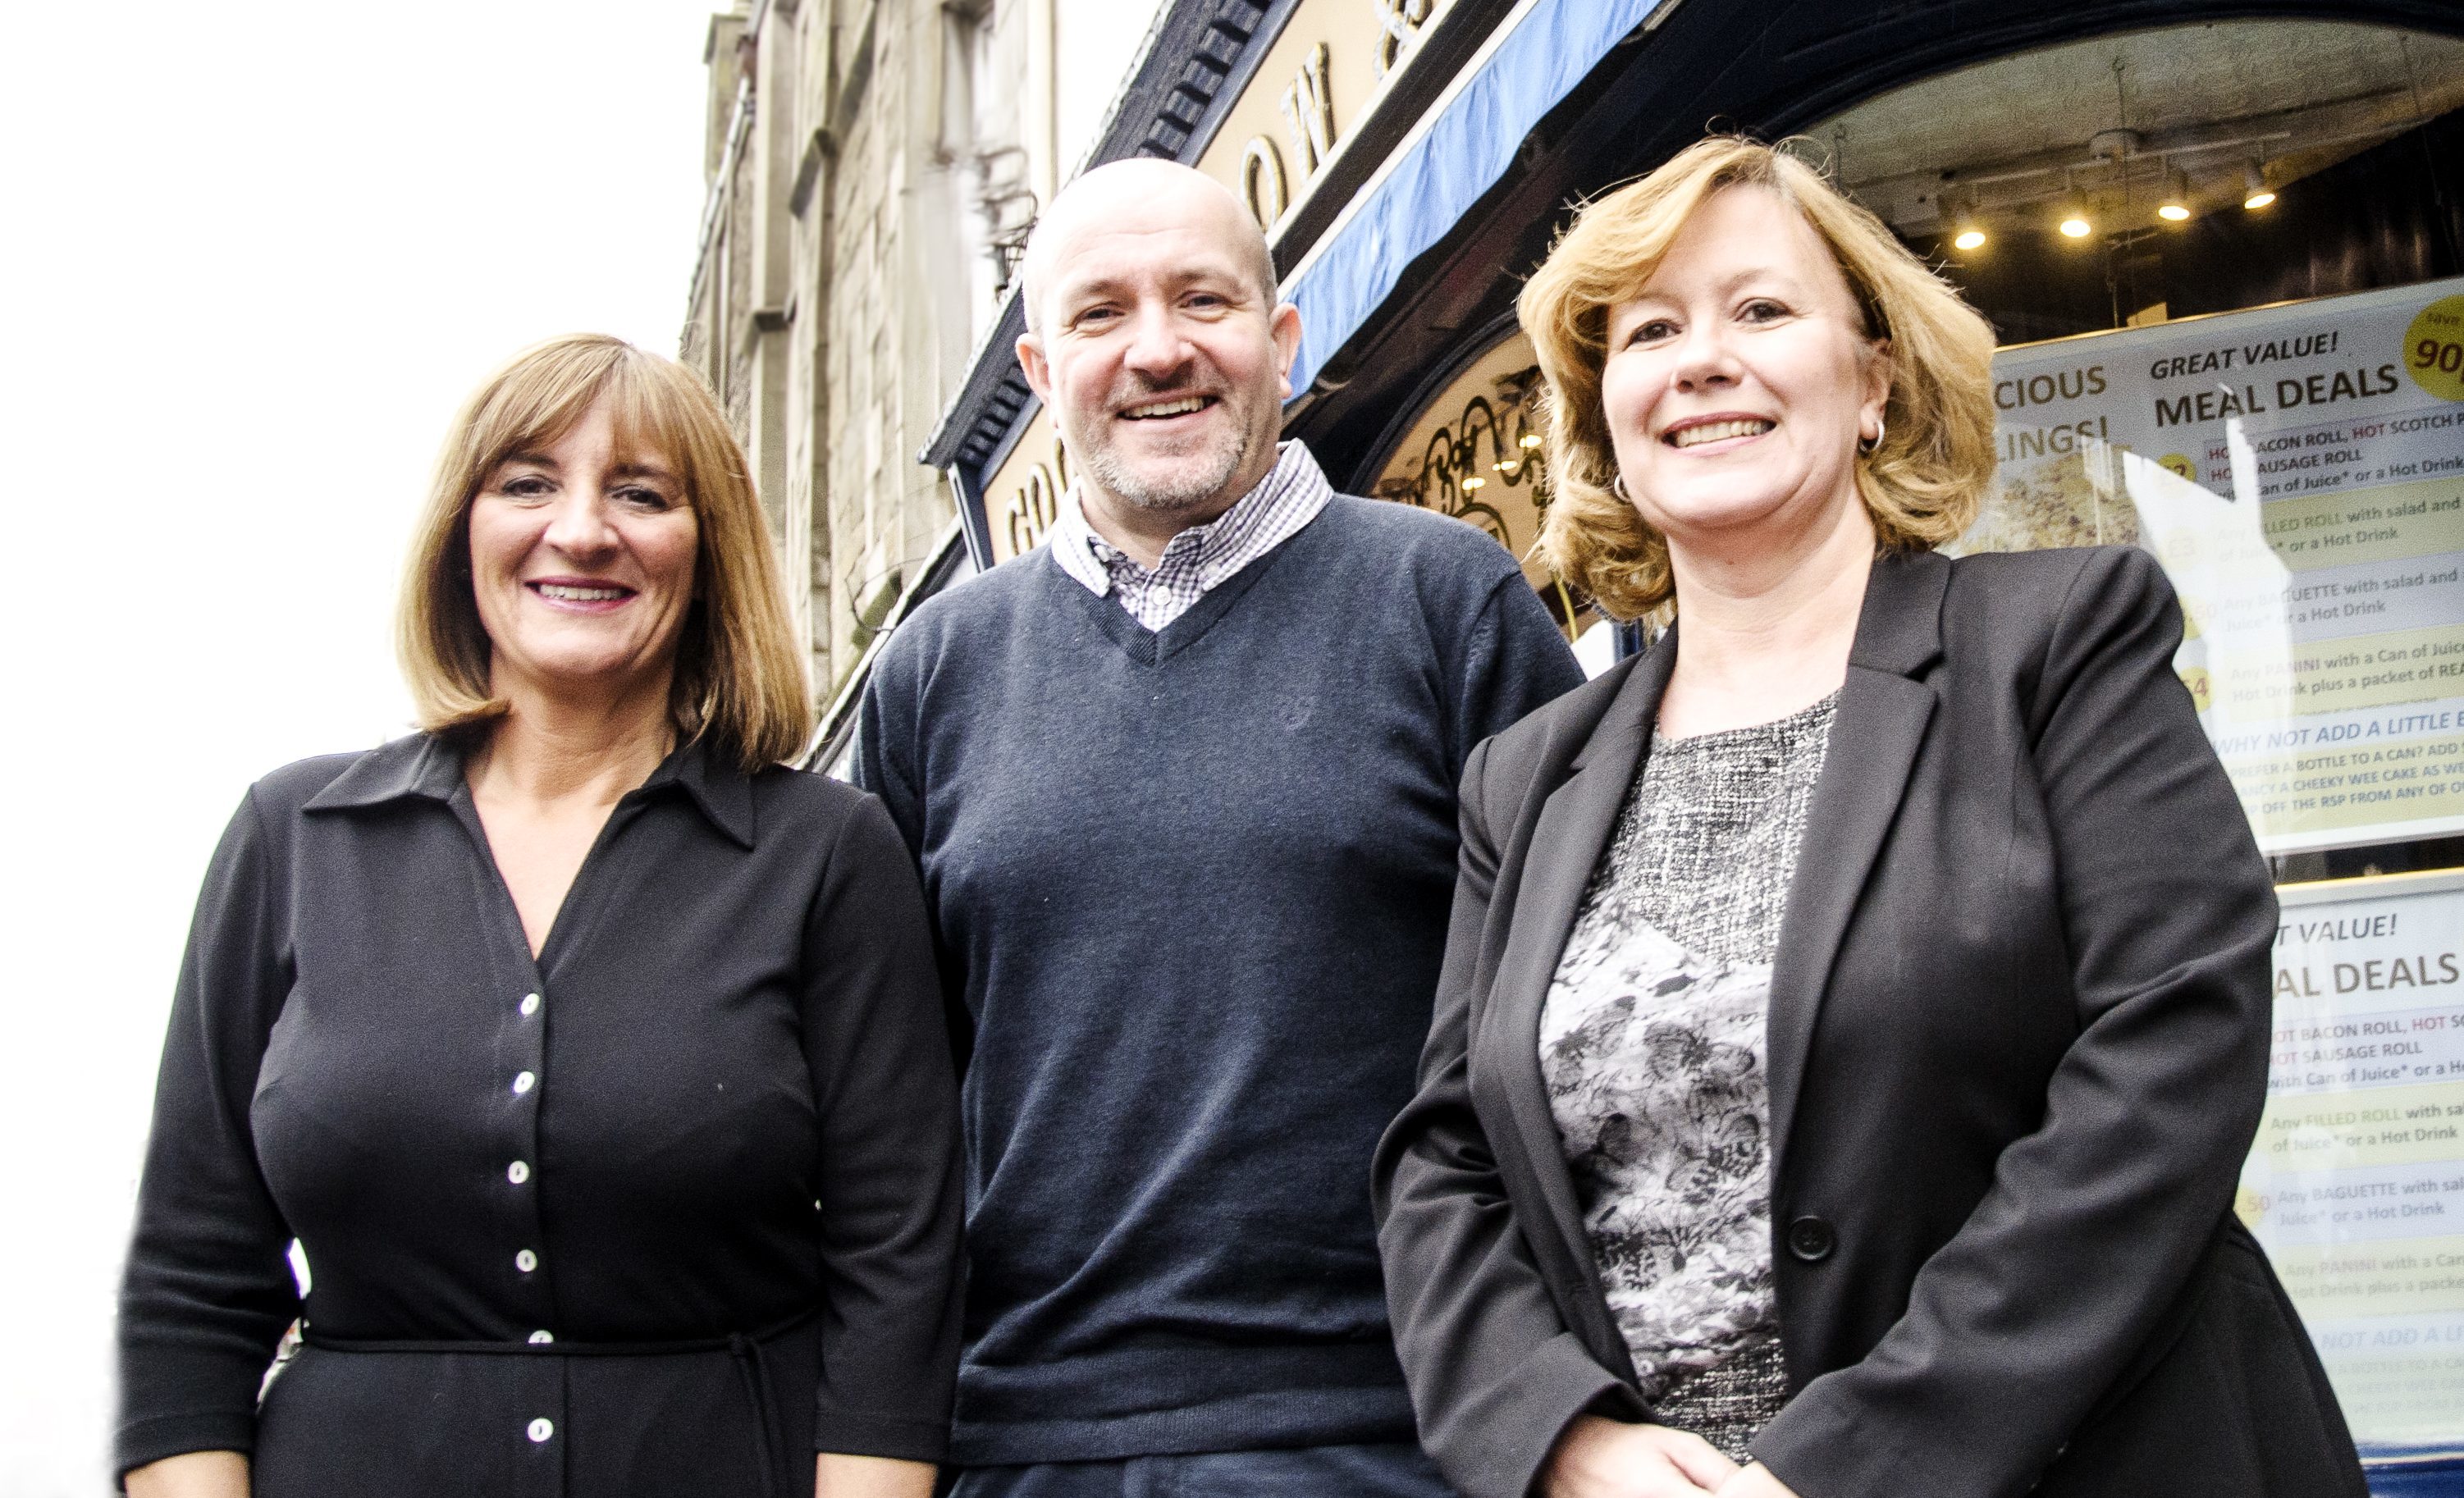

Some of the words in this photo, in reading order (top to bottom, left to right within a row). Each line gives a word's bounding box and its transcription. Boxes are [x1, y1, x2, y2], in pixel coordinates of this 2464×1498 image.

[2150, 348, 2236, 379] GREAT
[2244, 331, 2338, 366] VALUE!
[2155, 384, 2265, 427] MEAL
[2276, 363, 2400, 409] DEALS
[2000, 416, 2108, 462] INGS!
[2208, 446, 2229, 461] HO
[2256, 435, 2302, 454] ACON
[2352, 422, 2385, 440] HOT
[2389, 413, 2453, 434] SCOTCH
[2210, 467, 2232, 482] HO
[2257, 454, 2320, 475] AUSAGE
[2324, 448, 2362, 464] ROLL
[2283, 477, 2300, 492] of
[2355, 470, 2370, 482] or
[2375, 468, 2384, 479] a
[2389, 462, 2417, 478] Hot
[2304, 513, 2342, 531] ROLL
[2347, 505, 2381, 523] with
[2386, 498, 2426, 518] salad
[2431, 496, 2461, 513] and
[2289, 541, 2304, 553] or
[2323, 530, 2351, 547] Hot
[2356, 526, 2398, 544] Drink
[2344, 576, 2379, 594] with
[2383, 572, 2424, 590] salad
[2429, 567, 2458, 583] and
[2297, 611, 2306, 622] a
[2311, 605, 2338, 621] Hot
[2343, 600, 2386, 615] Drink
[2324, 654, 2360, 670] with
[2364, 654, 2373, 664] a
[2378, 649, 2407, 662] Can
[2411, 643, 2428, 657] of
[2433, 641, 2464, 656] Juic
[2311, 678, 2343, 696] plus
[2348, 678, 2357, 688] a
[2361, 669, 2414, 689] packet
[2419, 665, 2434, 679] of
[2267, 728, 2312, 748] NOT
[2315, 722, 2361, 744] ADD
[2366, 719, 2380, 737] A
[2388, 711, 2451, 735] LITTLE
[2283, 761, 2293, 773] A
[2296, 753, 2347, 772] BOTTLE
[2351, 751, 2370, 765] TO
[2373, 751, 2384, 763] A
[2386, 745, 2423, 761] CAN?
[2428, 742, 2459, 756] ADD
[2240, 783, 2276, 797] ANCY
[2279, 781, 2289, 793] A
[2293, 774, 2344, 792] CHEEKY
[2348, 771, 2379, 785] WEE
[2382, 767, 2417, 782] CAKE
[2423, 764, 2440, 777] AS
[2293, 797, 2315, 811] THE
[2320, 793, 2346, 807] RSP
[2350, 789, 2392, 805] FROM
[2396, 785, 2424, 800] ANY
[2428, 782, 2446, 796] OF
[2299, 913, 2398, 944] VALUE!
[2334, 952, 2460, 994] DEALS
[2274, 1029, 2295, 1044] OT
[2301, 1024, 2358, 1042] BACON
[2411, 1015, 2447, 1030] HOT
[2302, 1044, 2378, 1064] SAUSAGE
[2381, 1040, 2424, 1057] ROLL
[2306, 1071, 2336, 1086] Can
[2340, 1067, 2357, 1083] of
[2413, 1064, 2432, 1077] or
[2435, 1064, 2445, 1076] a
[2306, 1110, 2357, 1127] FILLED
[2361, 1108, 2401, 1124] ROLL
[2405, 1103, 2442, 1120] with
[2346, 1135, 2364, 1148] or
[2367, 1134, 2377, 1145] a
[2381, 1130, 2411, 1144] Hot
[2415, 1125, 2459, 1142] Drink
[2278, 1190, 2306, 1205] Any
[2311, 1181, 2398, 1201] BAGUETTE
[2401, 1178, 2439, 1194] with
[2331, 1211, 2349, 1223] or
[2368, 1206, 2398, 1221] Hot
[2401, 1201, 2444, 1217] Drink
[2382, 1254, 2417, 1270] with
[2321, 1331, 2367, 1350] NOT
[2372, 1327, 2419, 1347] ADD
[2424, 1326, 2439, 1344] A
